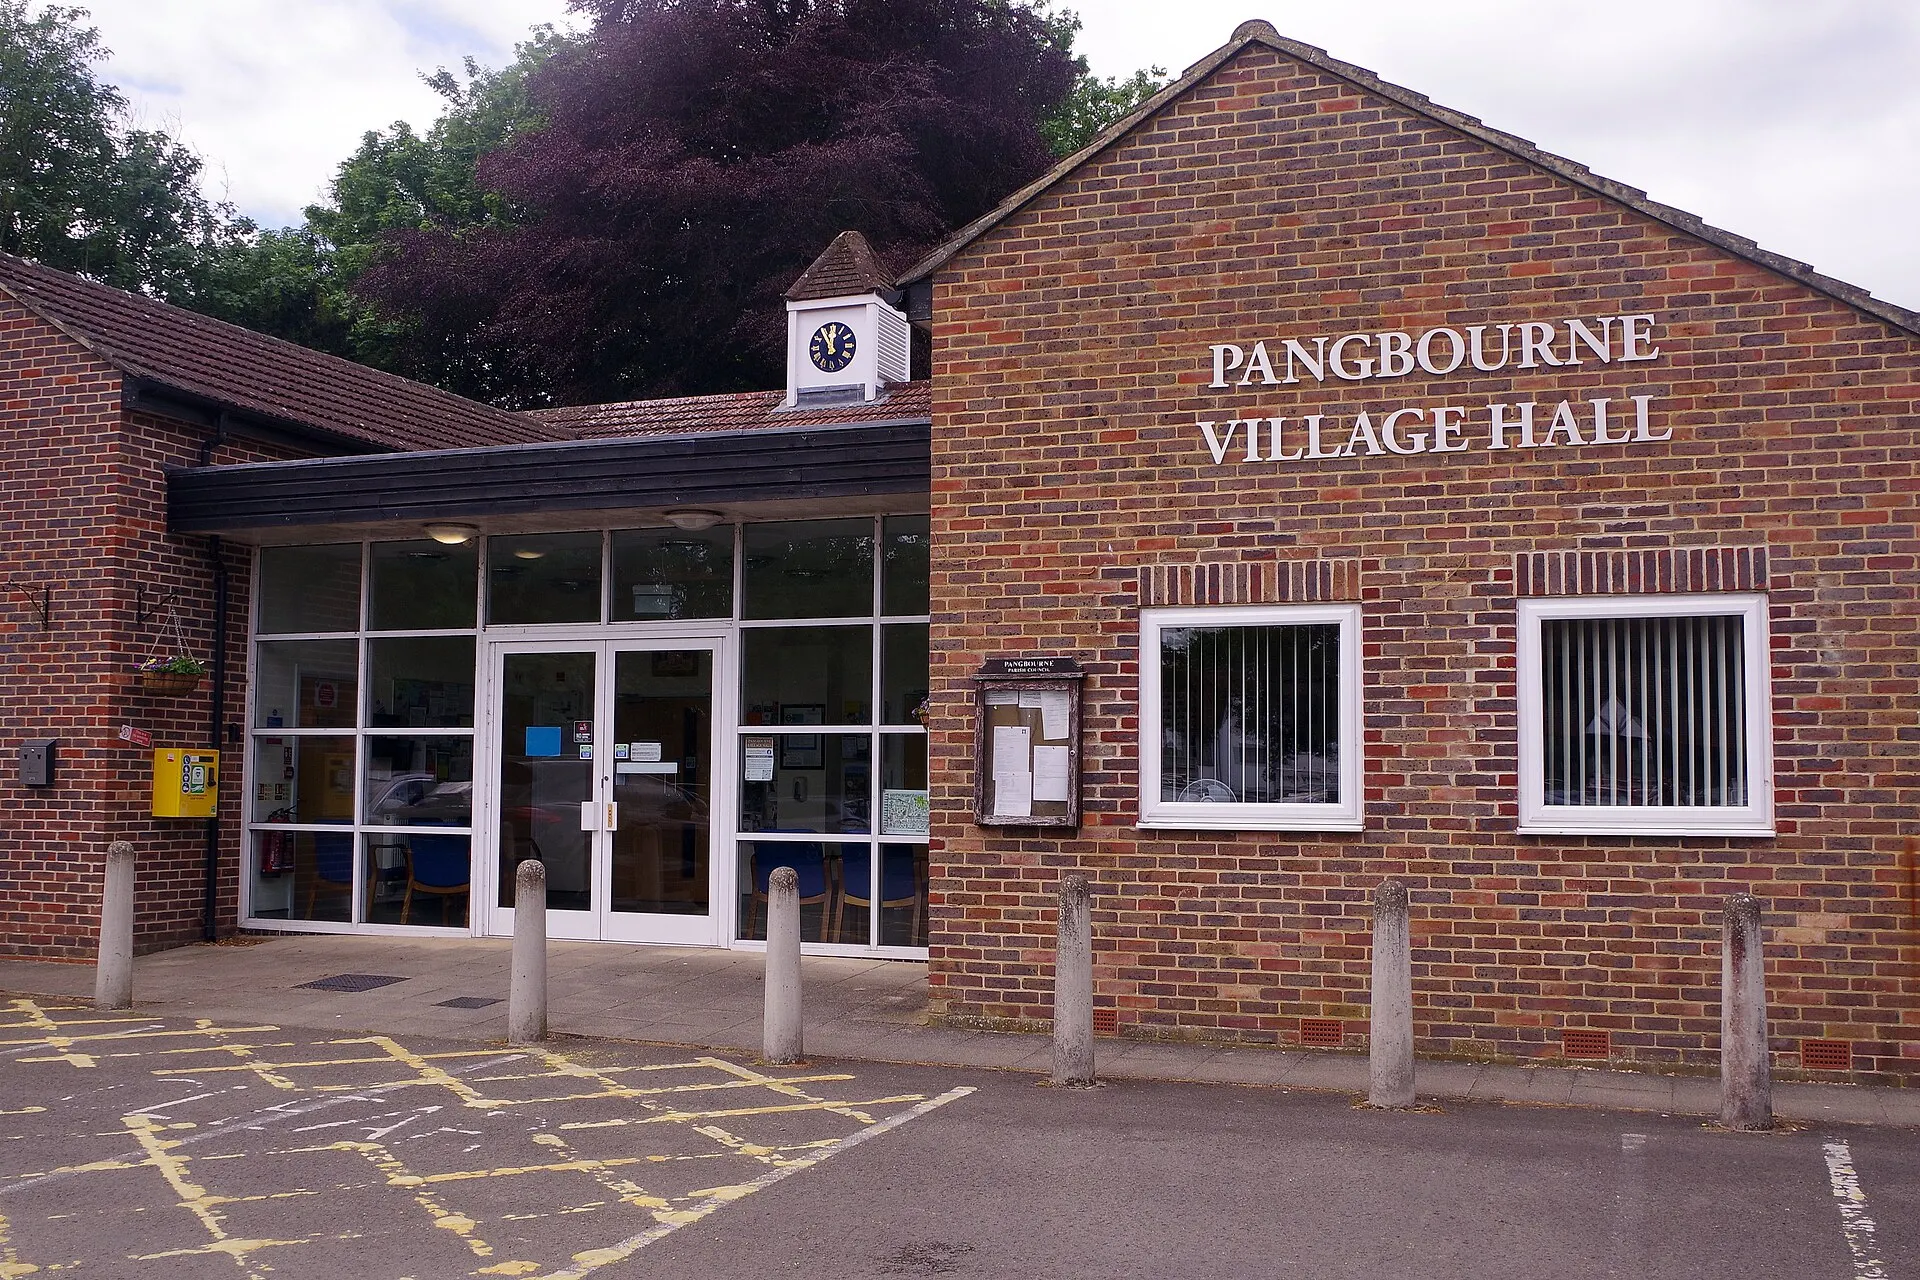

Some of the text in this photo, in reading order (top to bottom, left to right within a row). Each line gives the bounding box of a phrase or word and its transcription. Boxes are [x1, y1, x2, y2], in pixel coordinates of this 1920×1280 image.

[1207, 313, 1661, 389] PANGBOURNE
[1196, 394, 1674, 466] VILLAGE HALL
